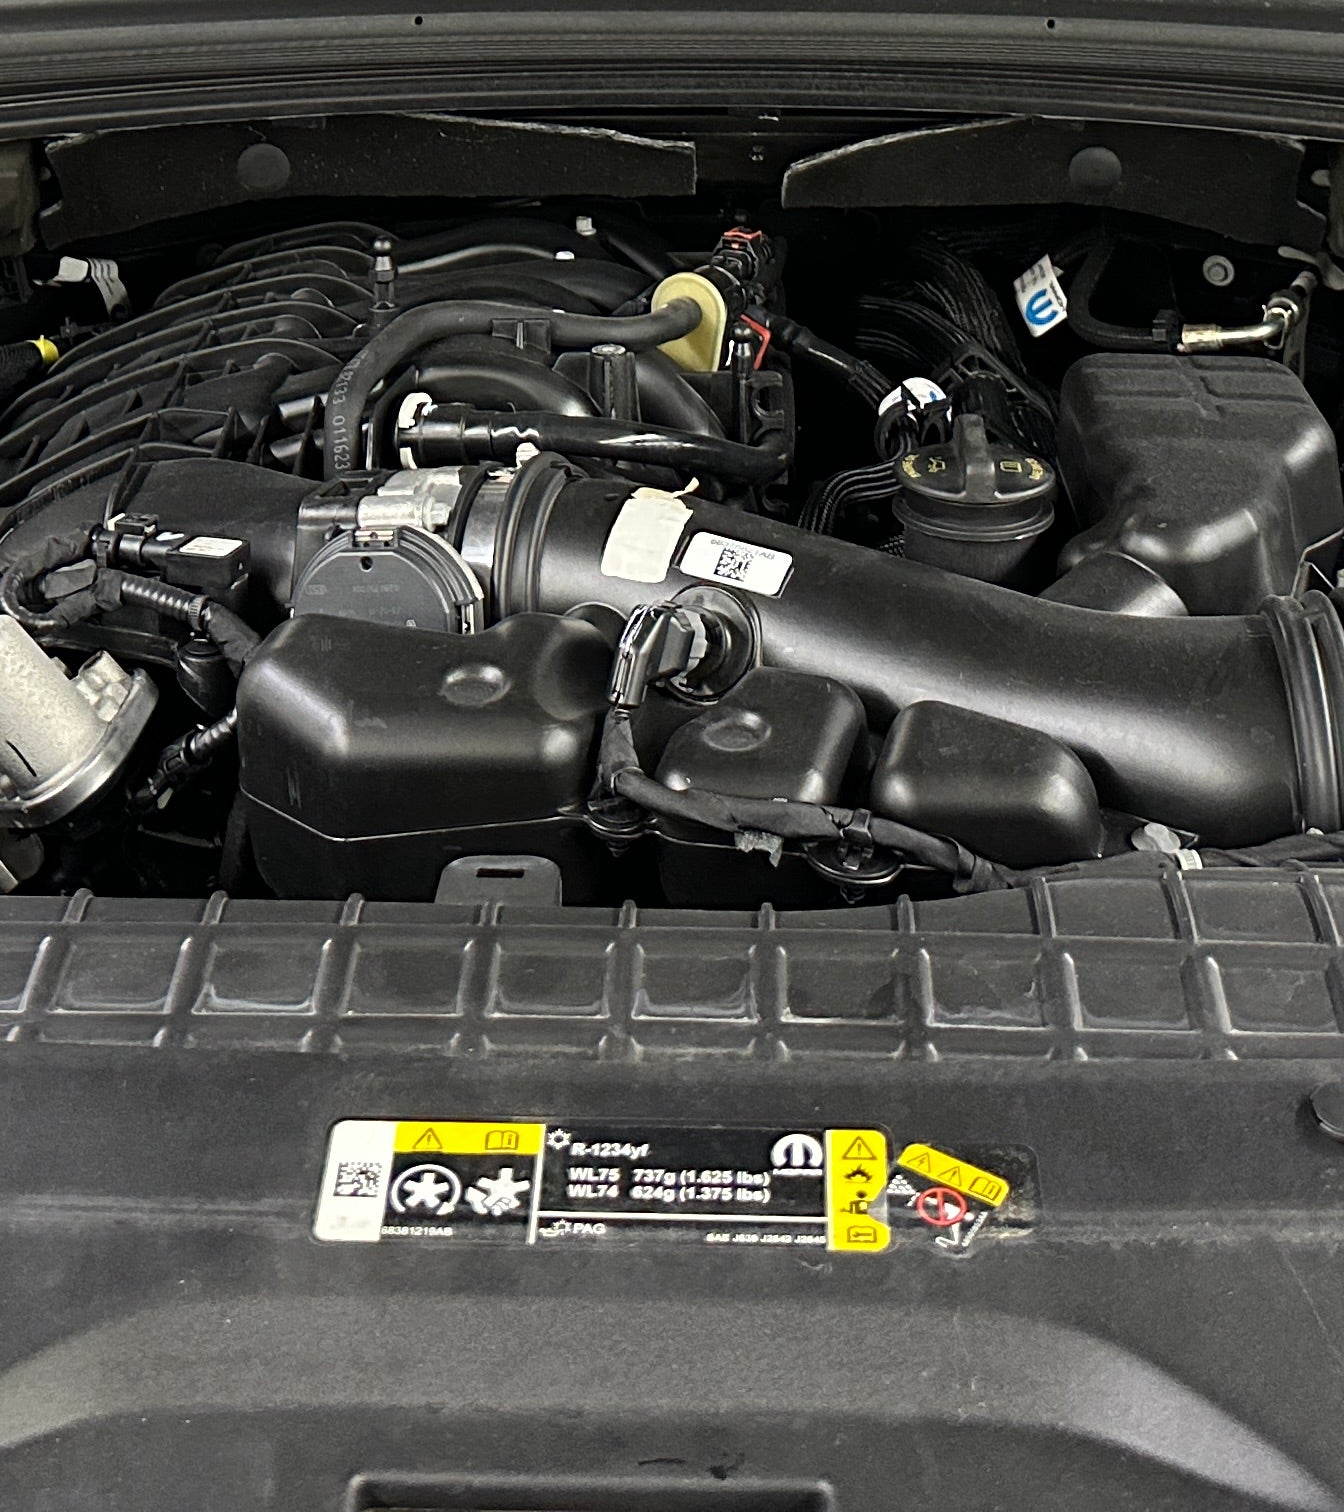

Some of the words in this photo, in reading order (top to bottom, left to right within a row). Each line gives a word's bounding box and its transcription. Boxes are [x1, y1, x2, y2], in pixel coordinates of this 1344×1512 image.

[332, 415, 351, 470] 011623
[570, 1142, 650, 1160] R-1234yf
[568, 1167, 621, 1182] WL75
[633, 1168, 676, 1186] 737g
[680, 1170, 733, 1185] (1.625
[736, 1171, 771, 1187] lbs)
[567, 1184, 620, 1199] WL74
[630, 1185, 676, 1202] 624g
[680, 1187, 733, 1202] (1.375
[736, 1188, 771, 1204] lbs)
[573, 1222, 606, 1235] PAG
